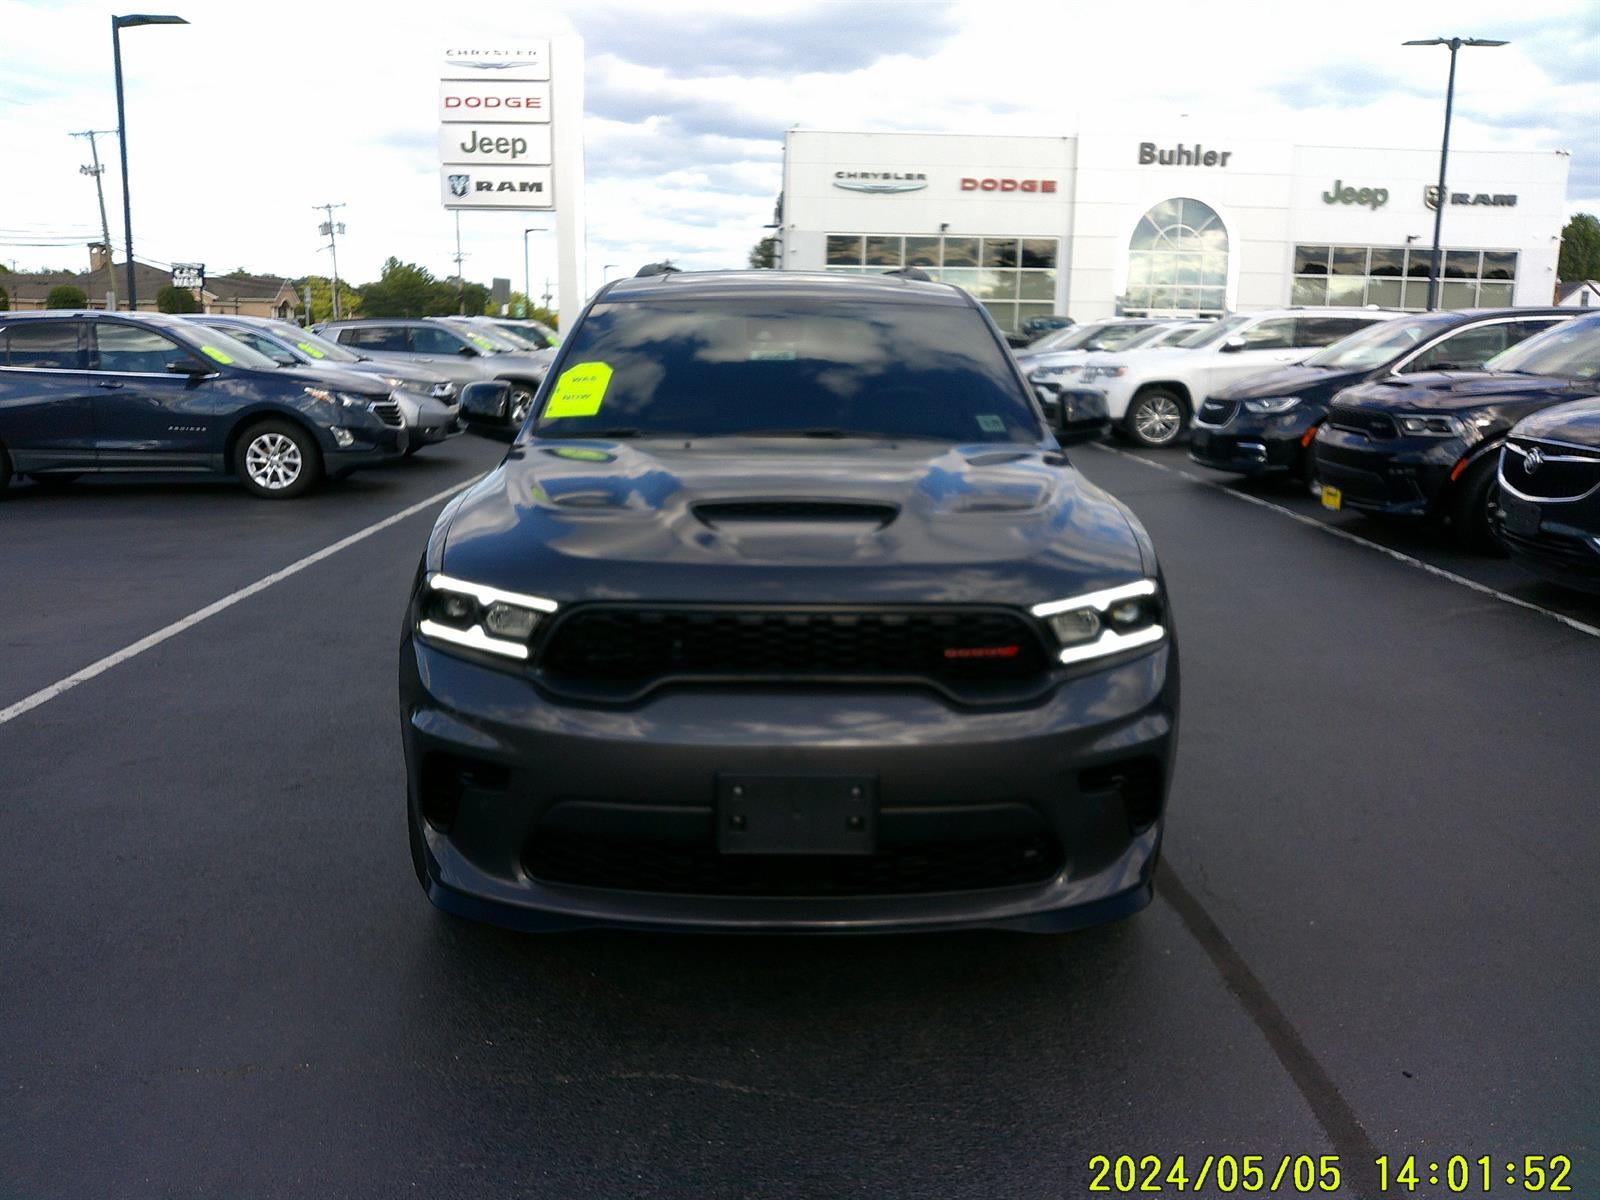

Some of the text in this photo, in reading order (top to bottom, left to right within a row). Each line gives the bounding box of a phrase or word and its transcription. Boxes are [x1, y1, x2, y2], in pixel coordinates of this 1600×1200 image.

[445, 96, 542, 108] DODGE
[460, 130, 527, 158] Jeep
[1139, 142, 1231, 167] Buhler
[834, 171, 927, 181] CHRYSLER
[476, 181, 543, 192] RAM
[961, 178, 1056, 193] DODGE
[1323, 179, 1389, 210] Jeep
[1451, 192, 1517, 206] RAM
